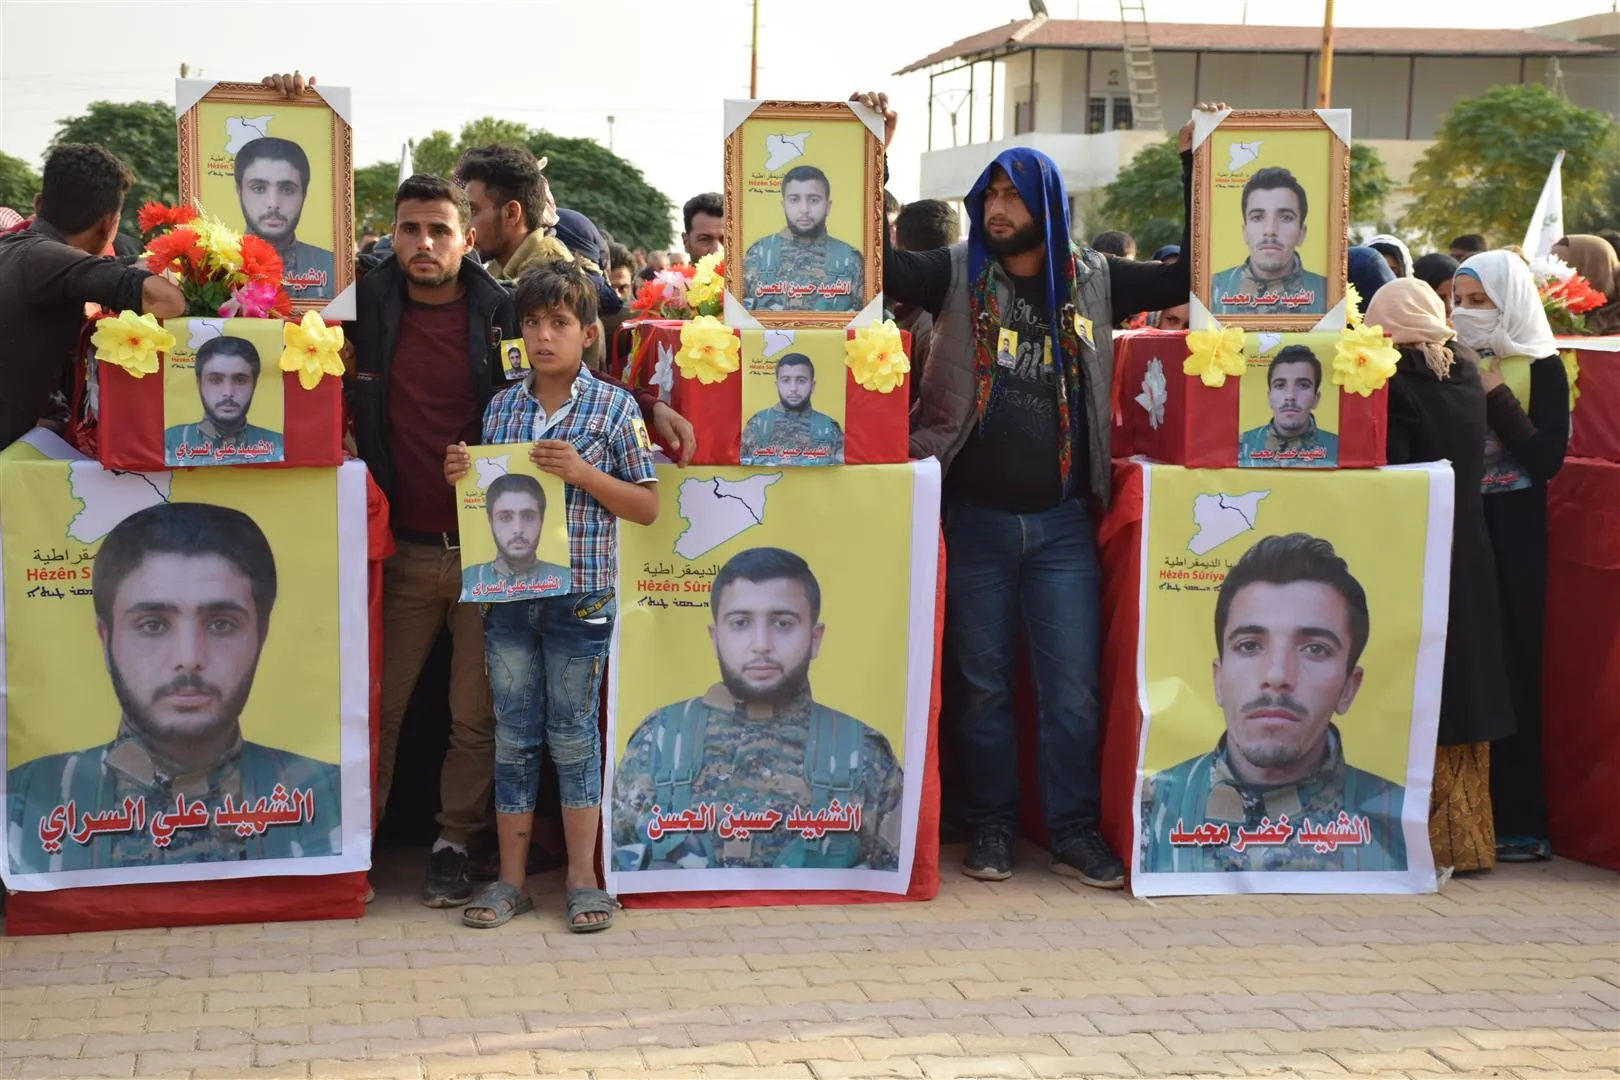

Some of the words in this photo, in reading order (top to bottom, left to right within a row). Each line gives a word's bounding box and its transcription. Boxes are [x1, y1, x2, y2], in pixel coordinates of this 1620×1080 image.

[755, 280, 787, 298] الحسن
[787, 280, 817, 298] حسين
[817, 278, 852, 298] الشهيد
[1220, 291, 1251, 305] محمد
[1250, 289, 1280, 307] خضر
[1280, 288, 1315, 308] الشهيد
[175, 440, 214, 460] السراي
[214, 441, 236, 460] علي
[237, 439, 274, 458] الشهيد
[32, 548, 97, 565] مقراطية
[26, 566, 77, 581] Hêzên
[1159, 569, 1190, 580] Hêzên
[506, 580, 527, 597] علي
[527, 574, 563, 593] الشهيد
[637, 579, 680, 592] Hêzên
[683, 580, 712, 593] Sûri
[151, 793, 210, 846] علي
[215, 783, 314, 837] الشهيد
[786, 799, 862, 839] الشهيد
[39, 795, 145, 851] السراي
[647, 802, 716, 839] الحسن
[718, 802, 782, 839] حسين
[1169, 817, 1230, 845] محمد
[1231, 813, 1293, 852] خضر
[1298, 810, 1371, 853] الشهيد
